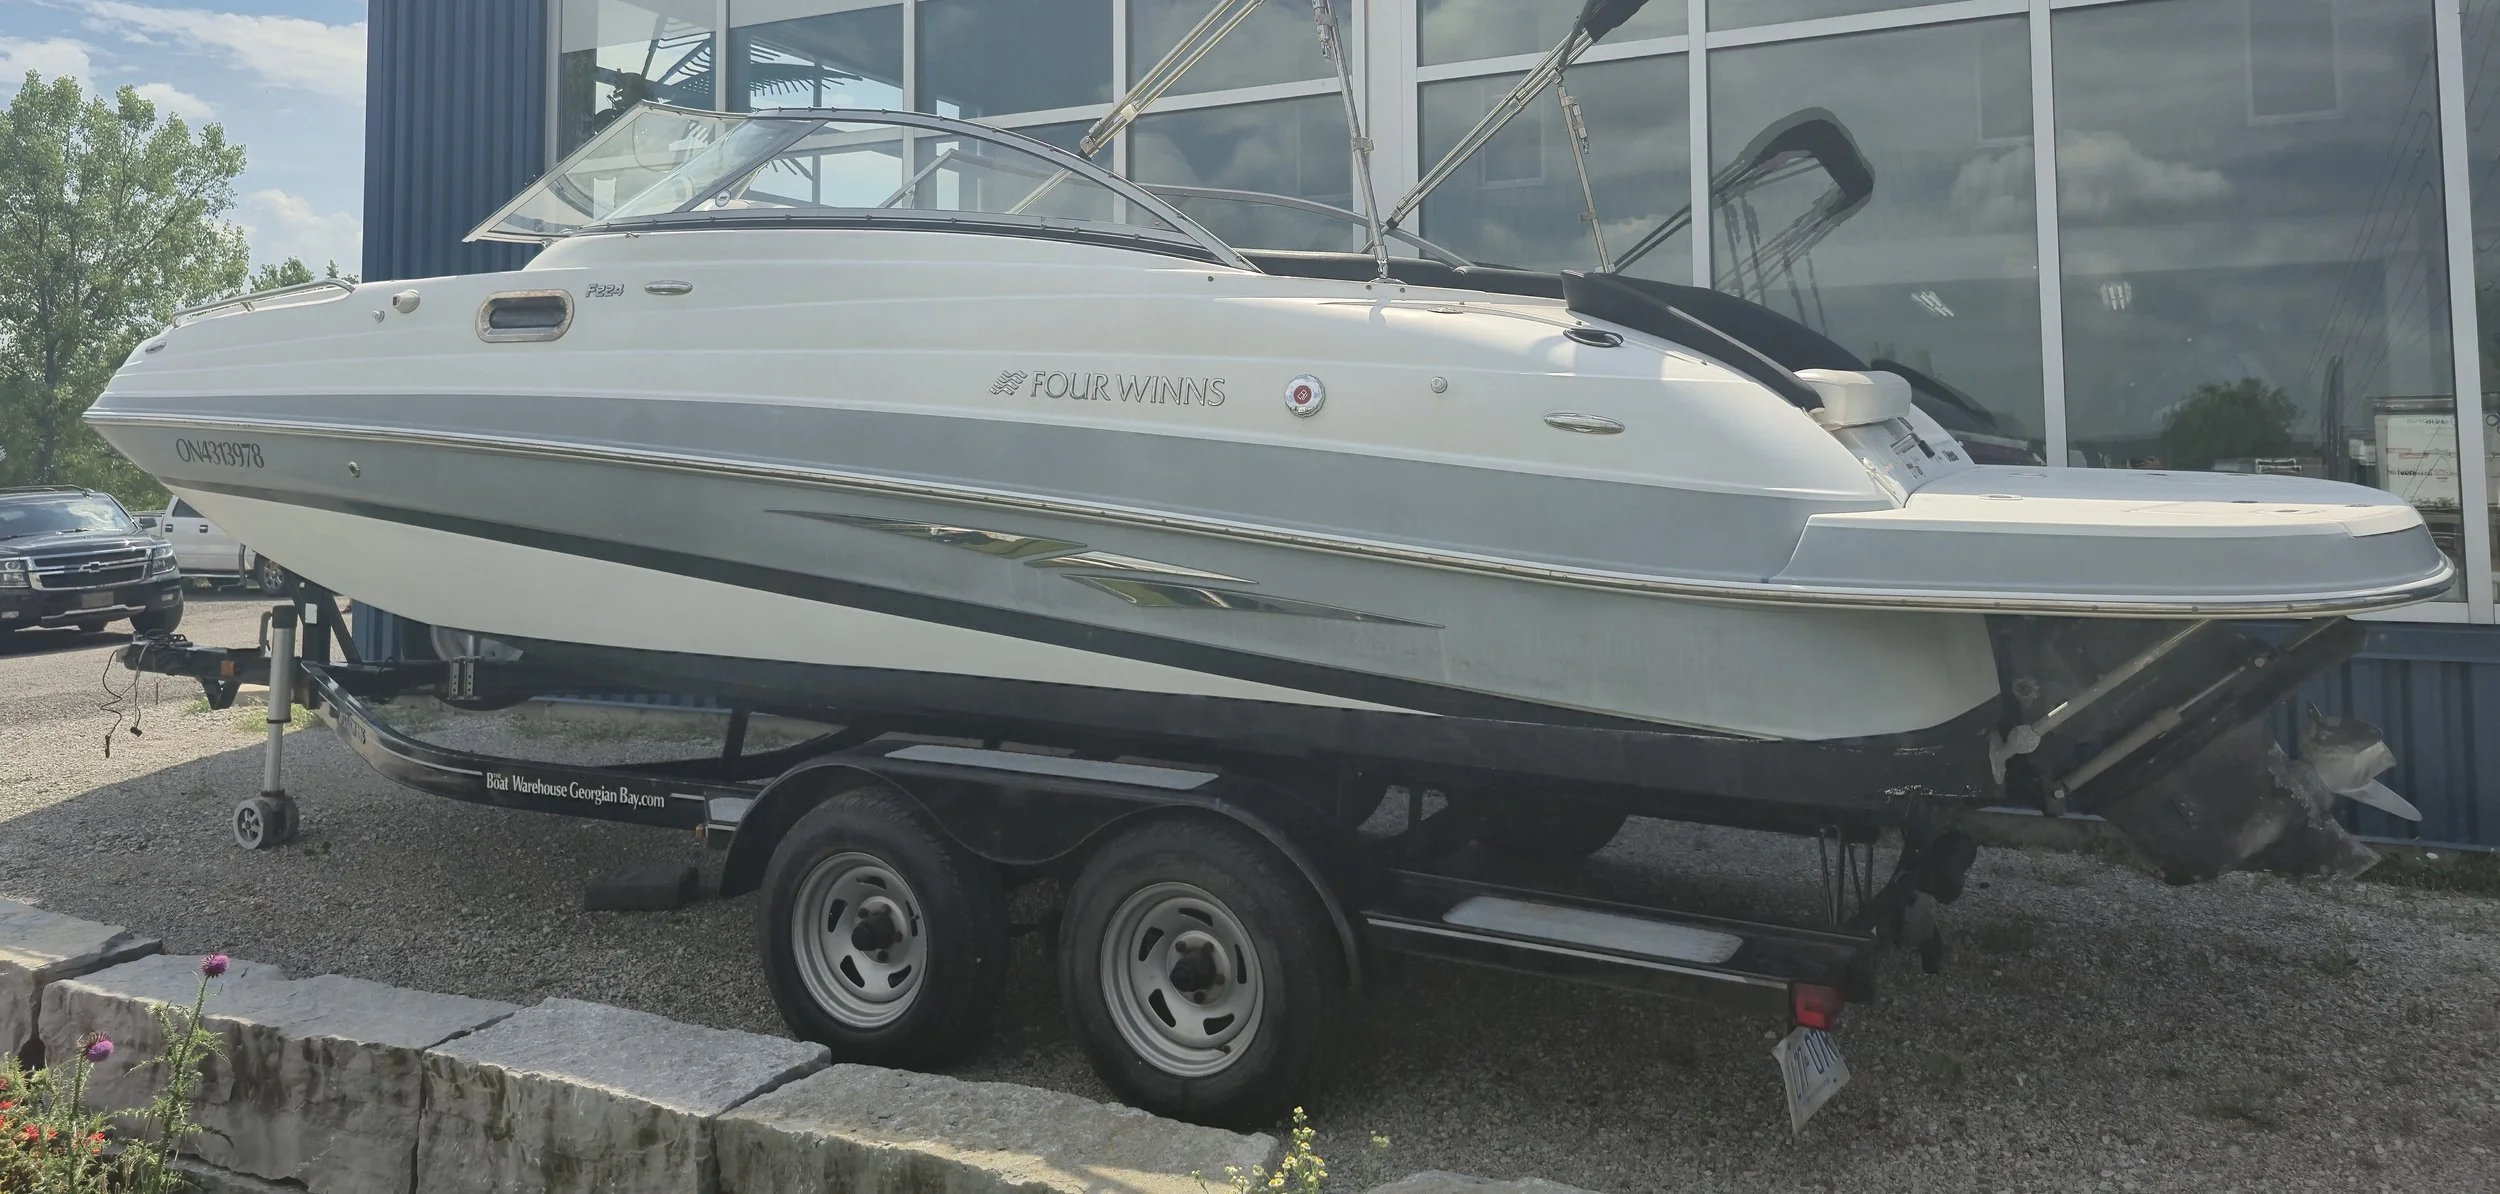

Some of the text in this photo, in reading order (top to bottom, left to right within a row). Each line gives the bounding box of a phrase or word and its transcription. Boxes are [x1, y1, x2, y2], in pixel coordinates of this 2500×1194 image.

[585, 283, 625, 298] F224
[1030, 370, 1226, 407] FOUR WINNS
[175, 438, 265, 469] ON4313978
[486, 772, 665, 810] Boat Warehouse Georgian Bay.com
